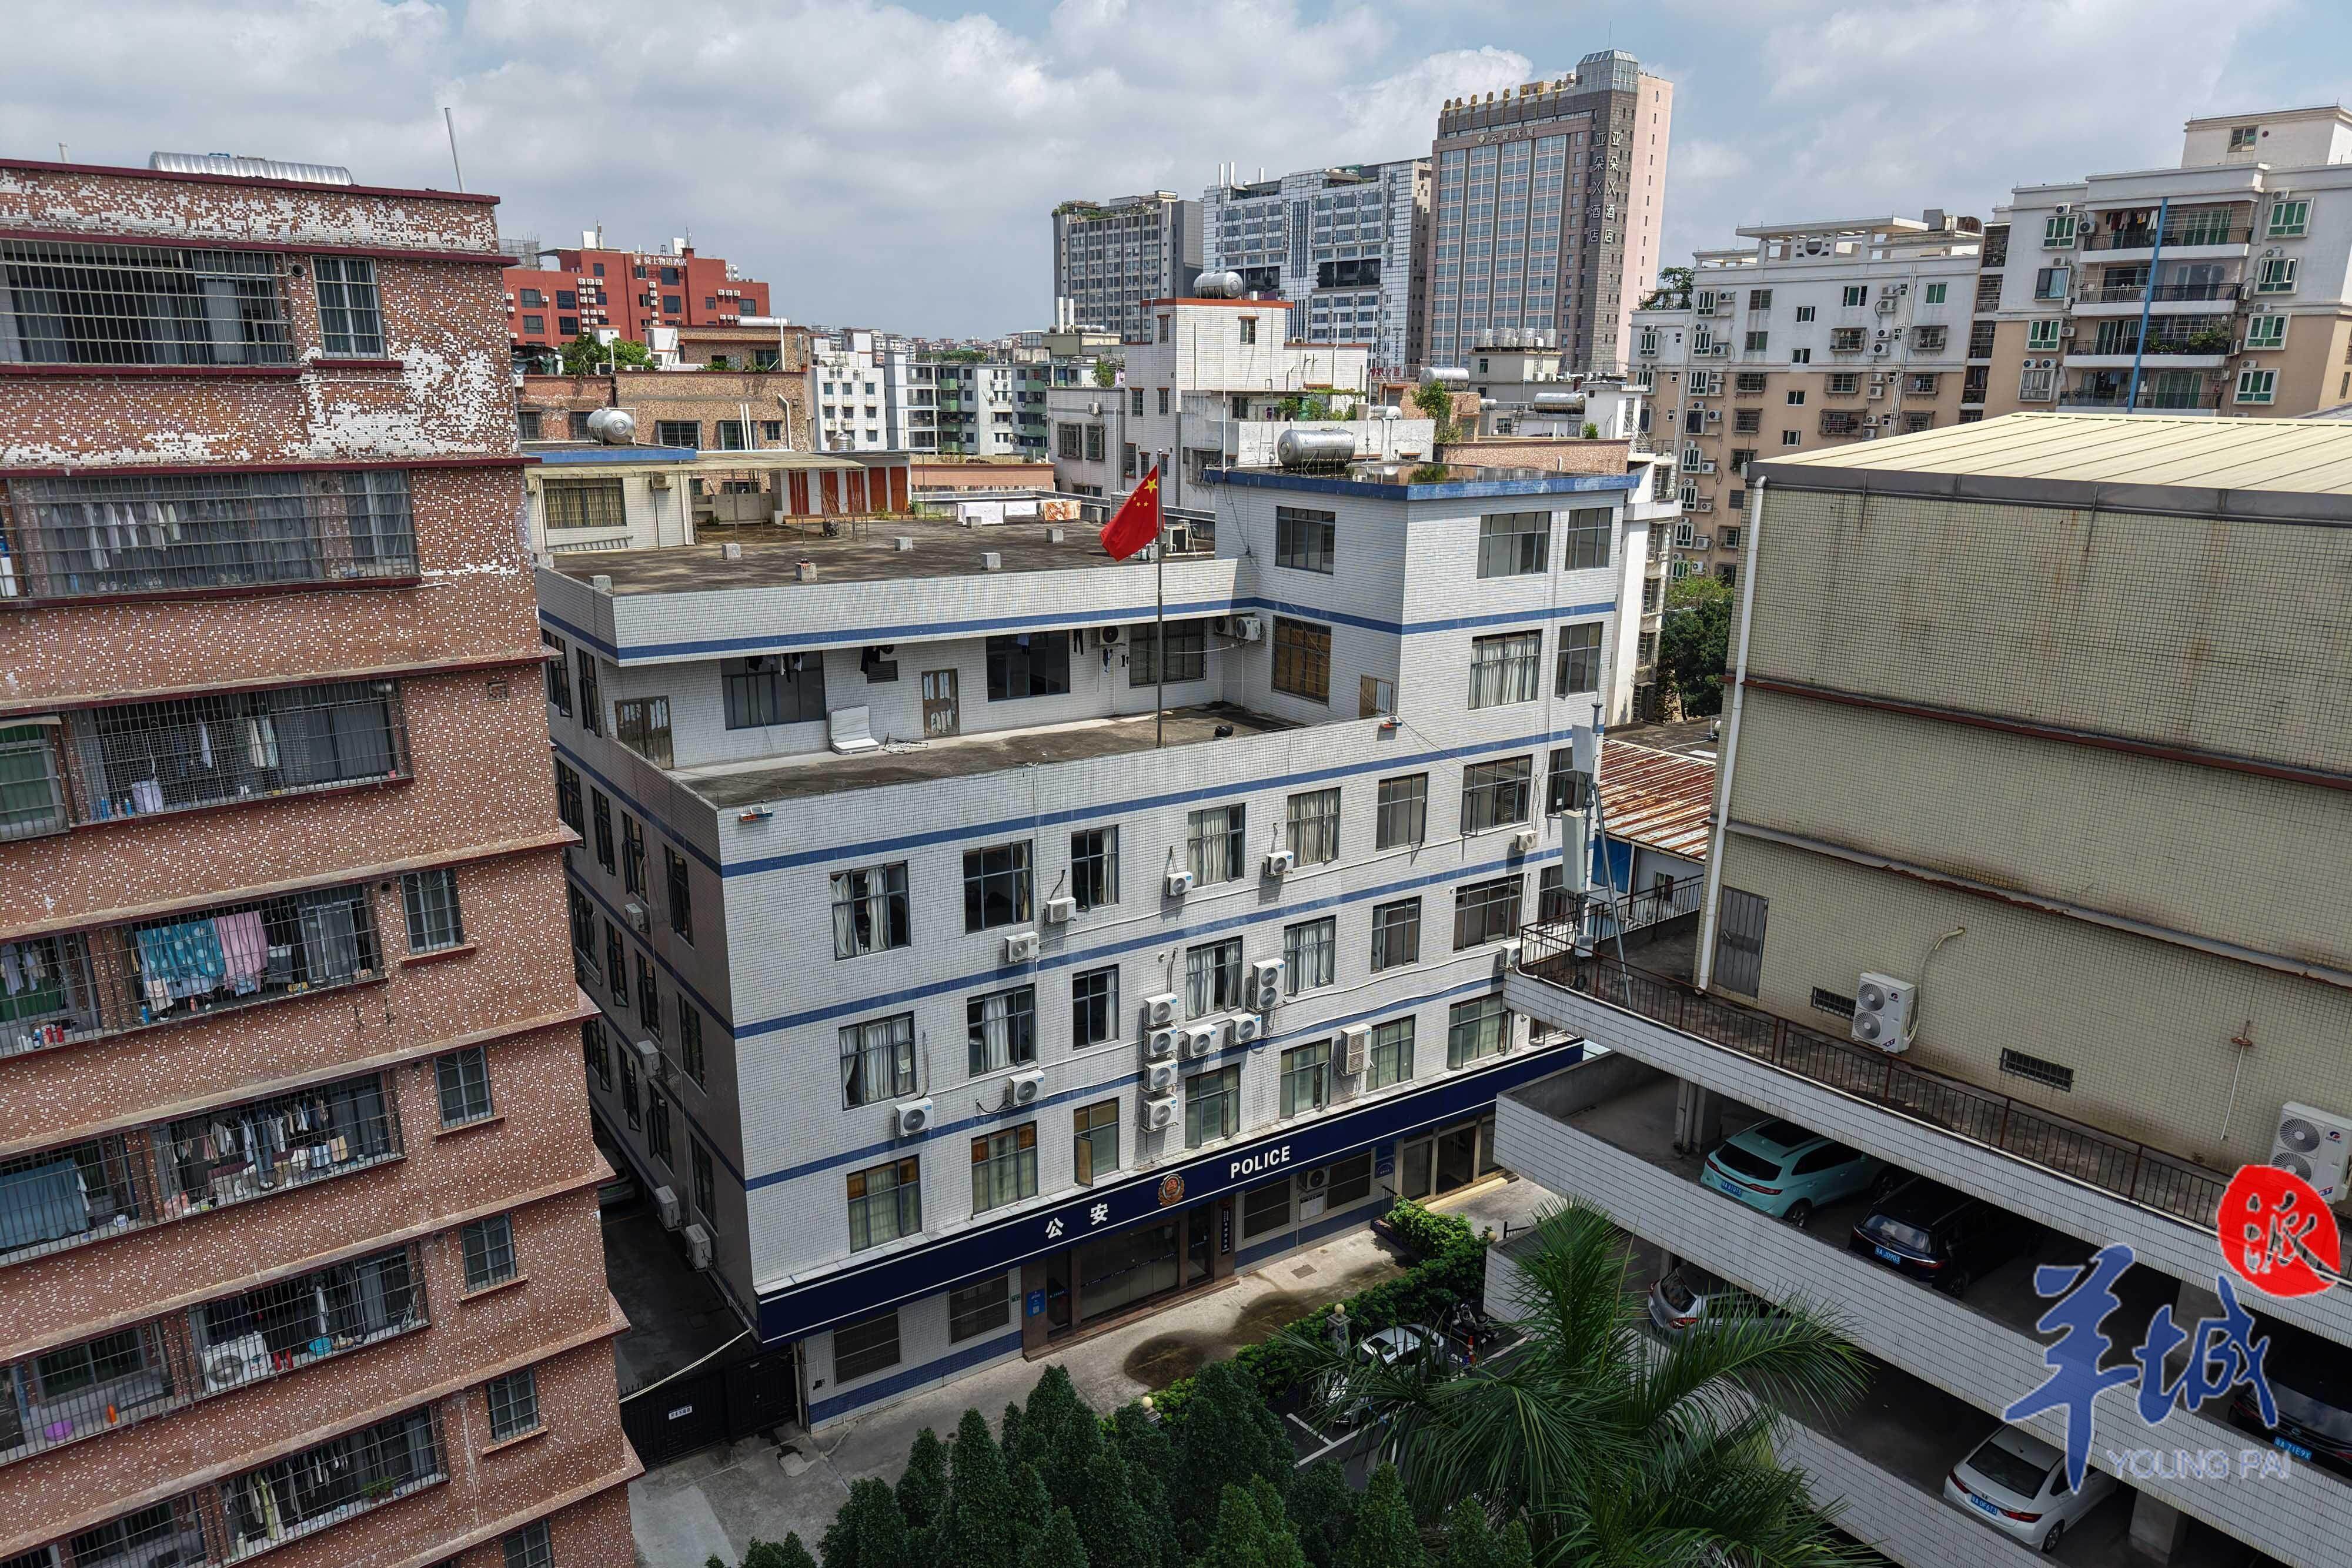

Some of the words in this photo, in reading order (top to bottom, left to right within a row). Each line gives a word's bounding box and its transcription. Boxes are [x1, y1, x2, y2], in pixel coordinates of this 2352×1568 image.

[1604, 131, 1621, 242] 亚朵X酒店
[1231, 1145, 1291, 1179] POLICE
[1045, 1203, 1108, 1239] 公安
